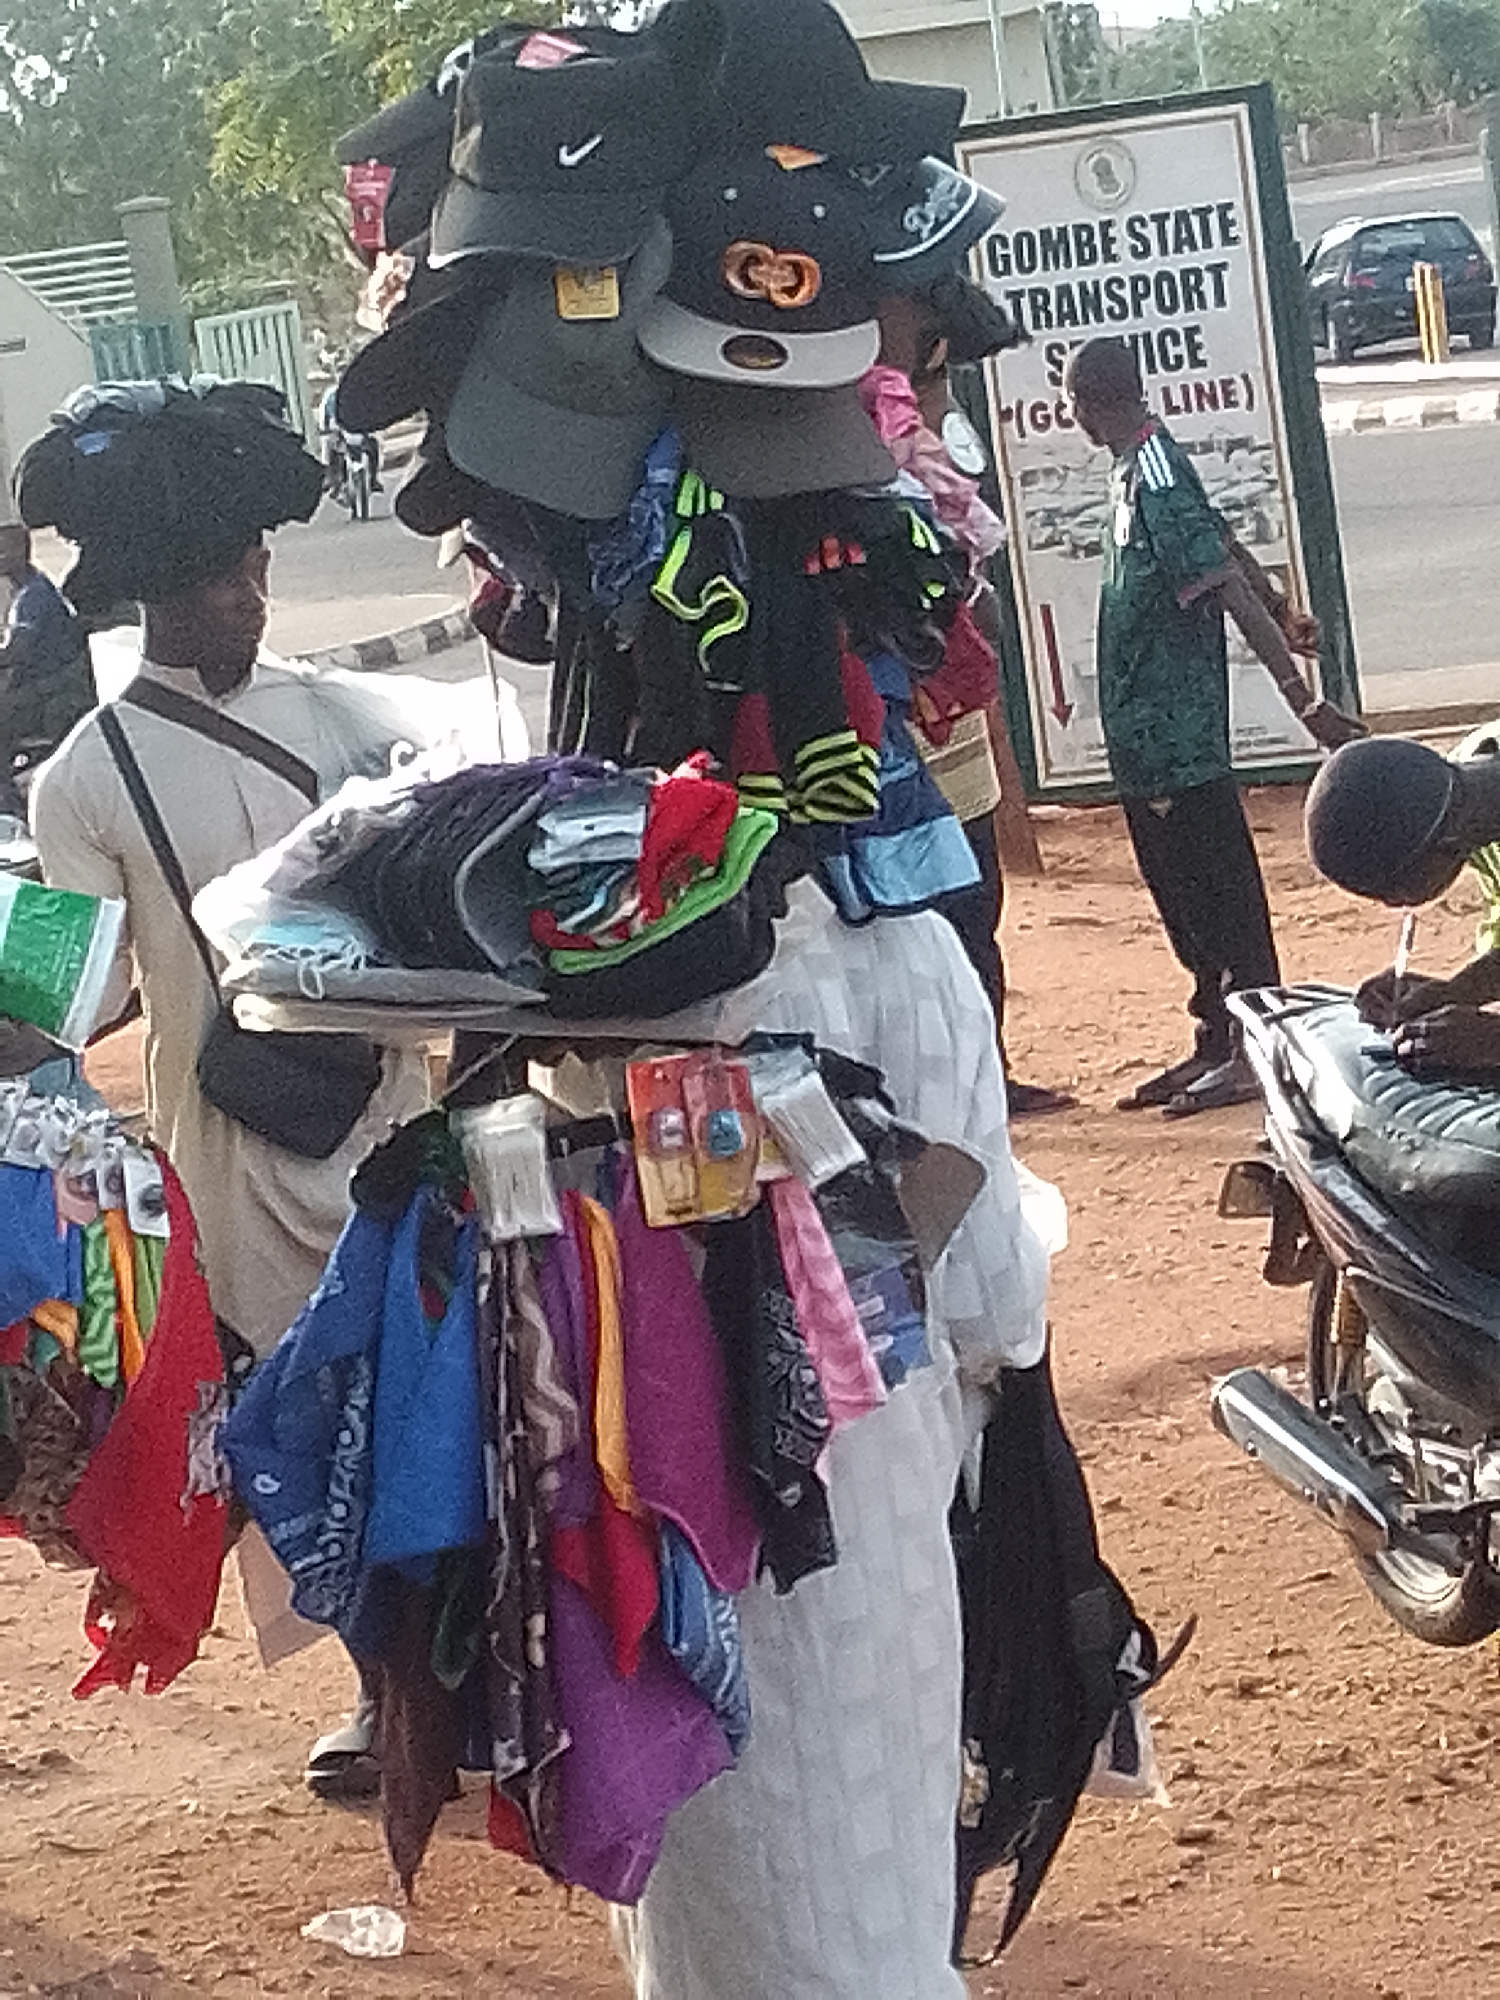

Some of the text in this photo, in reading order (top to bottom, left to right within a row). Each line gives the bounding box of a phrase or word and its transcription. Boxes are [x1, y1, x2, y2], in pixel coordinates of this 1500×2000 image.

[988, 202, 1241, 277] GOMBE STATE
[1006, 262, 1228, 330] TRANSPORT
[1046, 325, 1207, 386] SICE
[1162, 373, 1254, 416] LINE)
